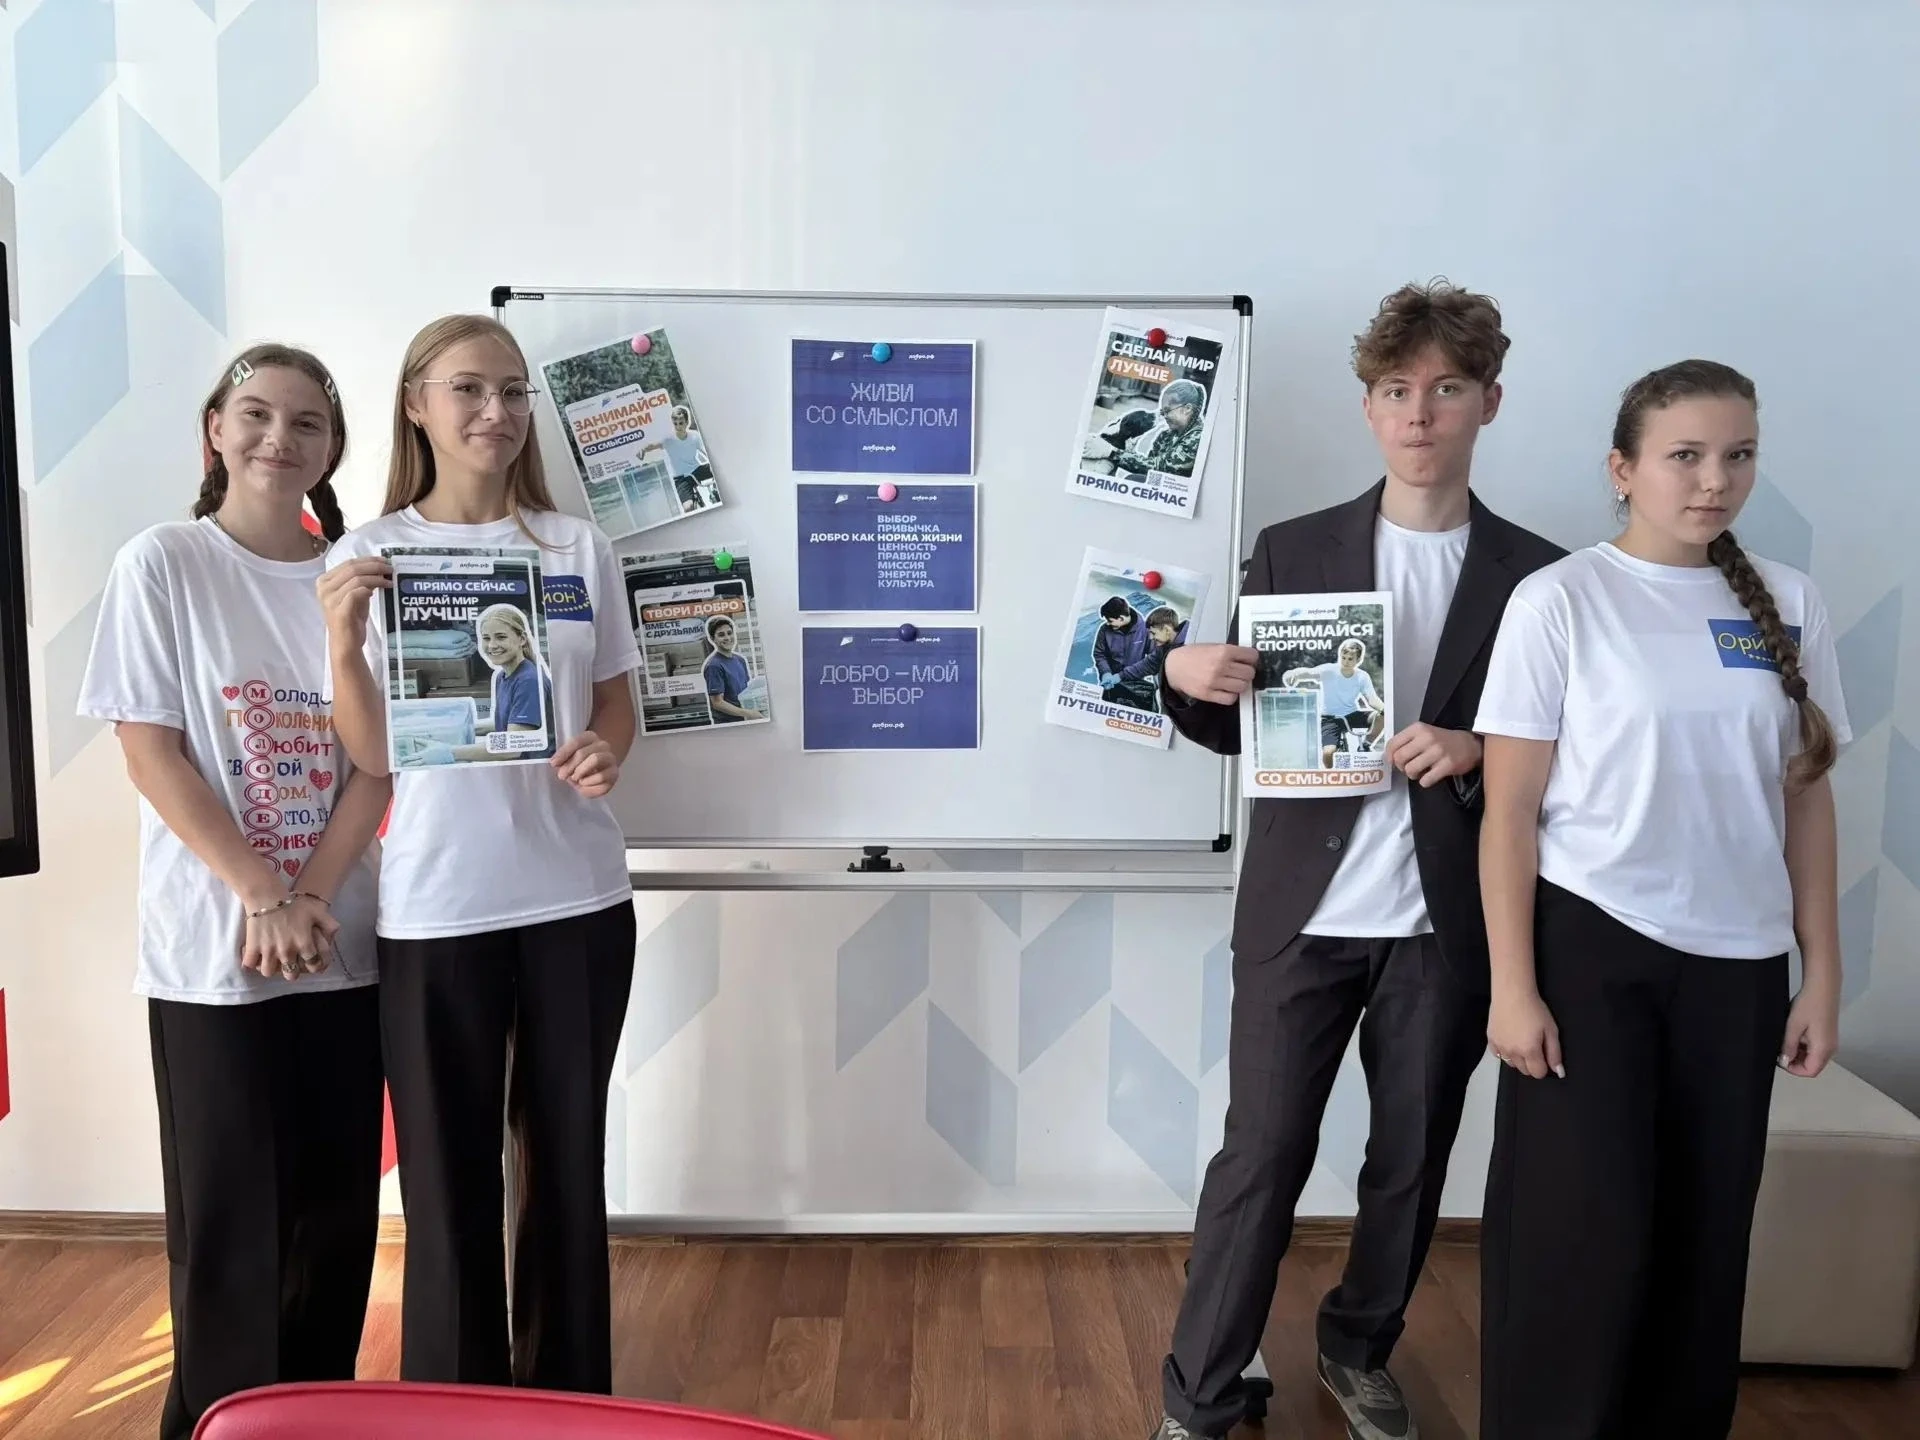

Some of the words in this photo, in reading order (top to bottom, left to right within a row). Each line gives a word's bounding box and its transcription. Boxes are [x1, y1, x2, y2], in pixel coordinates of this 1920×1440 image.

[1111, 340, 1176, 365] СДЕЛАЙ
[1178, 354, 1214, 372] МИР
[1110, 359, 1170, 382] ЛУЧШЕ
[851, 382, 914, 402] ЖИВИ
[574, 393, 668, 432] ЗАНИМАЙСЯ
[806, 405, 835, 424] СО
[842, 407, 958, 427] СМЫСЛОМ
[578, 412, 653, 445] СПОРТОМ
[584, 445, 598, 455] СО
[598, 432, 643, 451] СМЫСЛОМ
[1076, 474, 1128, 494] ПРЯМО
[1131, 487, 1188, 507] СЕЙЧАС
[877, 515, 917, 524] ВЫБОР
[877, 524, 940, 533] ПРИВЫЧКА
[810, 533, 850, 543] ДОБРО
[852, 533, 875, 542] КАК
[877, 534, 919, 542] НОРМА
[921, 534, 963, 543] ЖИЗНИ
[877, 543, 937, 552] ЦЕННОСТЬ
[877, 552, 931, 561] ПРАВИЛО
[877, 561, 925, 570] МИССИЯ
[877, 570, 927, 579] ЭНЕРГИЯ
[413, 581, 462, 592] ПРЯМО
[463, 579, 516, 592] СЕЙЧАС
[878, 579, 935, 588] КУЛЬТУРА
[401, 594, 450, 606] СДЕЛАЙ
[452, 596, 479, 606] МИР
[403, 607, 479, 622] ЛУЧШЕ
[646, 604, 691, 619] ТВОРИ
[693, 601, 739, 616] ДОБРО
[644, 621, 681, 630] ВМЕСТЕ
[646, 631, 652, 639] С
[653, 626, 704, 639] ДРУЗЬЯМИ
[1256, 620, 1374, 638] ЗАНИМАЙСЯ
[1256, 639, 1332, 651] СПОРТОМ
[1718, 632, 1767, 655] Ори
[819, 665, 890, 685] ДОБРО
[912, 660, 959, 683] МОЙ
[852, 687, 924, 705] ВЫБОР
[1057, 695, 1163, 728] ПУТЕШЕСТВУЙ
[1108, 719, 1119, 727] СО
[1120, 722, 1160, 737] СМЫСЛОМ
[1258, 773, 1282, 785] СО
[1285, 771, 1380, 785] СМЫСЛОМ
